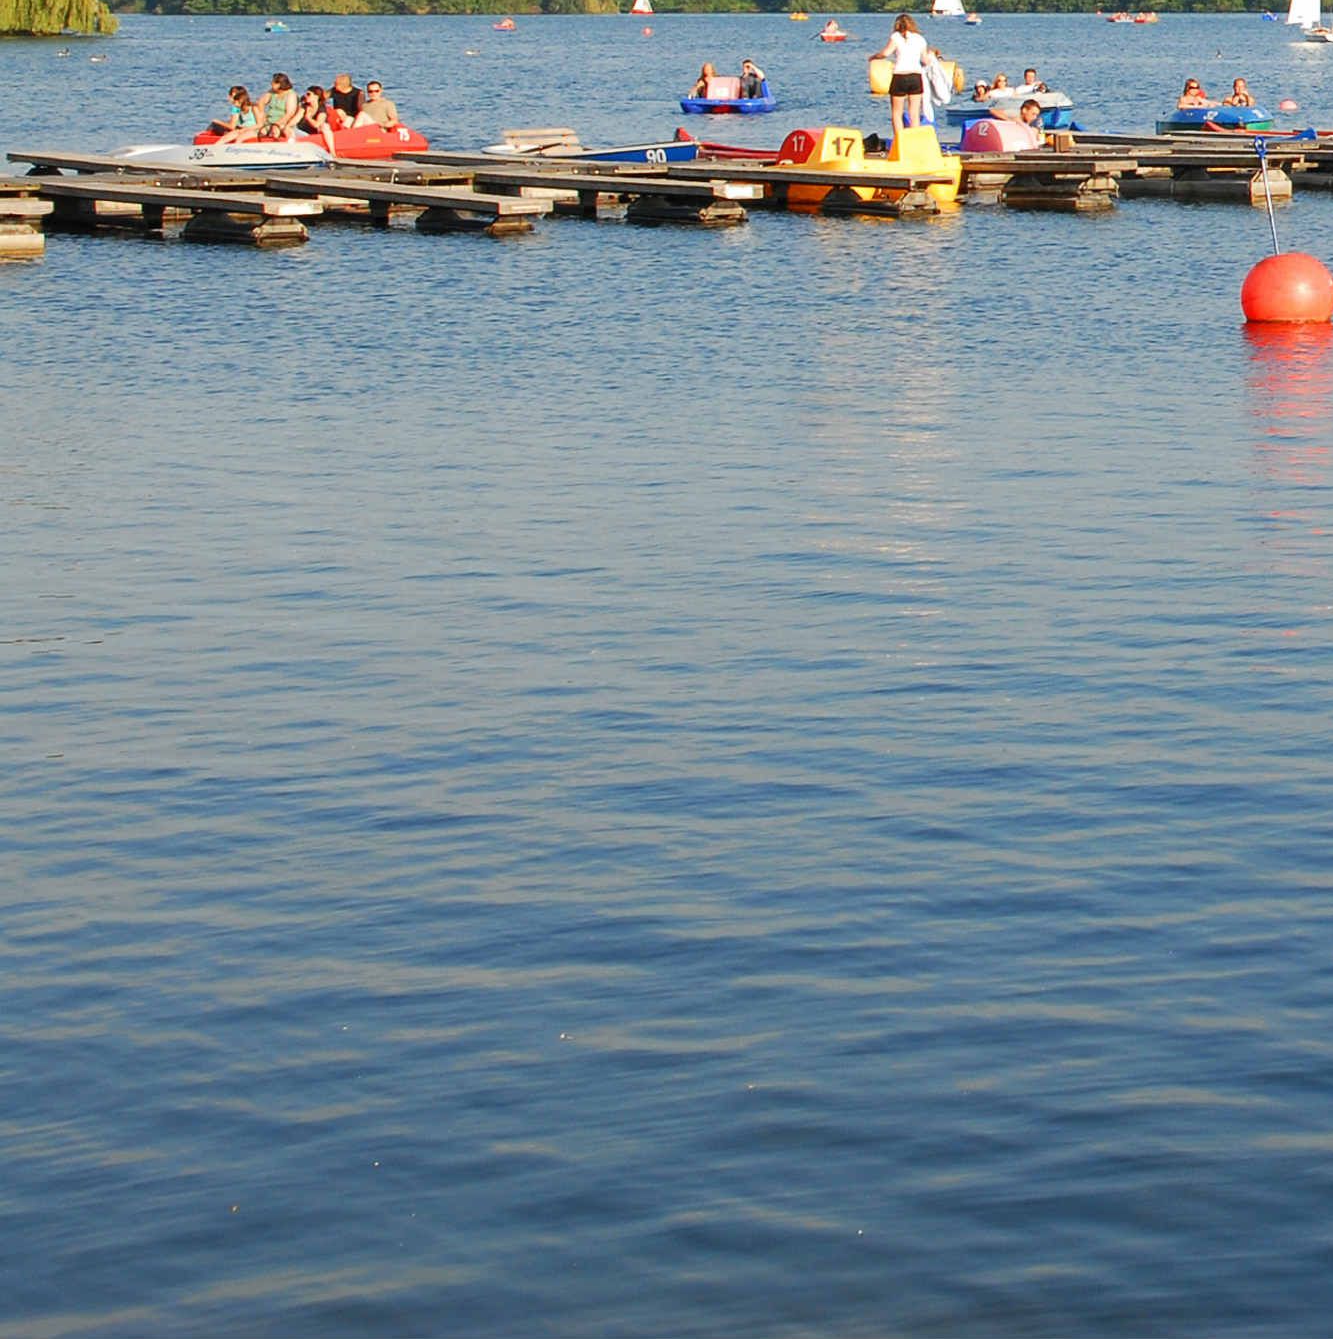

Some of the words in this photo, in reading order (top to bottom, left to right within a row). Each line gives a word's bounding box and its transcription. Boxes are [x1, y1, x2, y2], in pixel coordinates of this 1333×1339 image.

[978, 122, 990, 136] 12
[792, 135, 806, 152] 17
[832, 137, 855, 156] 17
[646, 149, 667, 165] 90
